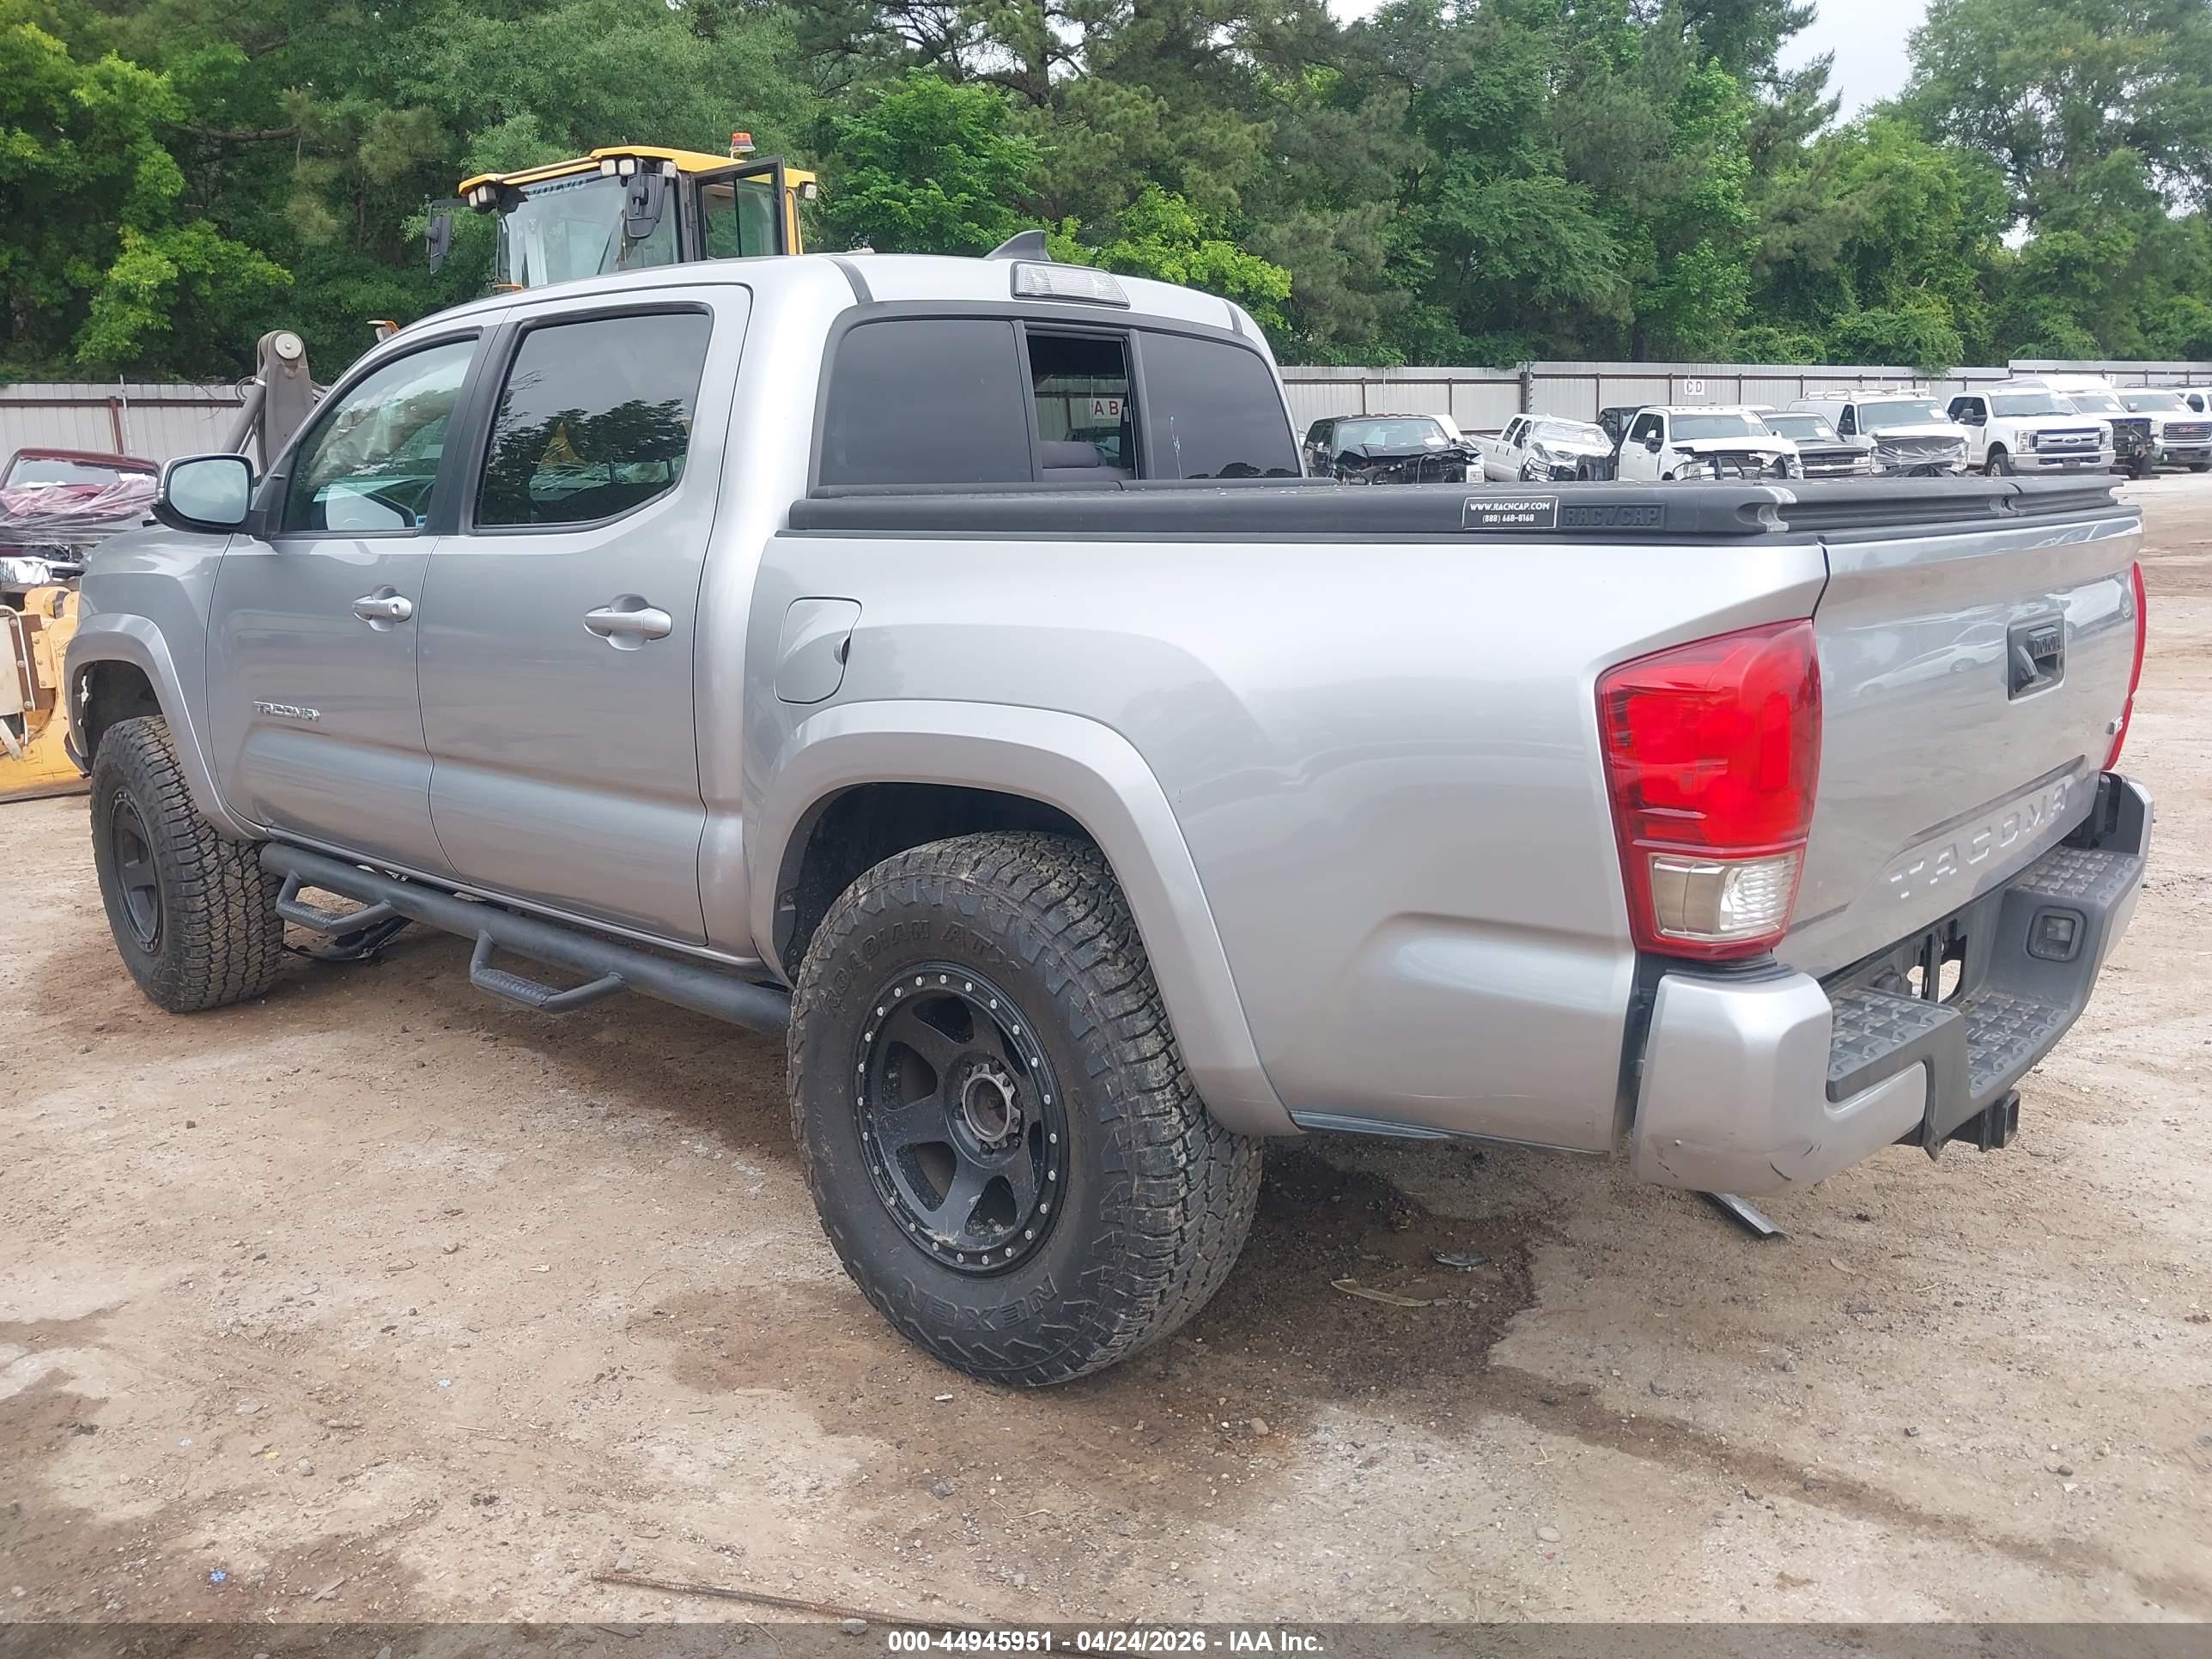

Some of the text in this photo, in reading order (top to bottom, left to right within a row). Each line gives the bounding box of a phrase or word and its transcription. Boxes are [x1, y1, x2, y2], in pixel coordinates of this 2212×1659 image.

[529, 178, 586, 198] VOLVO
[1469, 501, 1551, 512] WWW.RACNCAP.COM
[1482, 514, 1501, 524] (888)
[253, 701, 320, 721] TACOMA
[1890, 782, 2066, 900] TACOMA
[817, 920, 1022, 1018] ROADIAN ATX
[902, 1272, 1058, 1333] NEXEN
